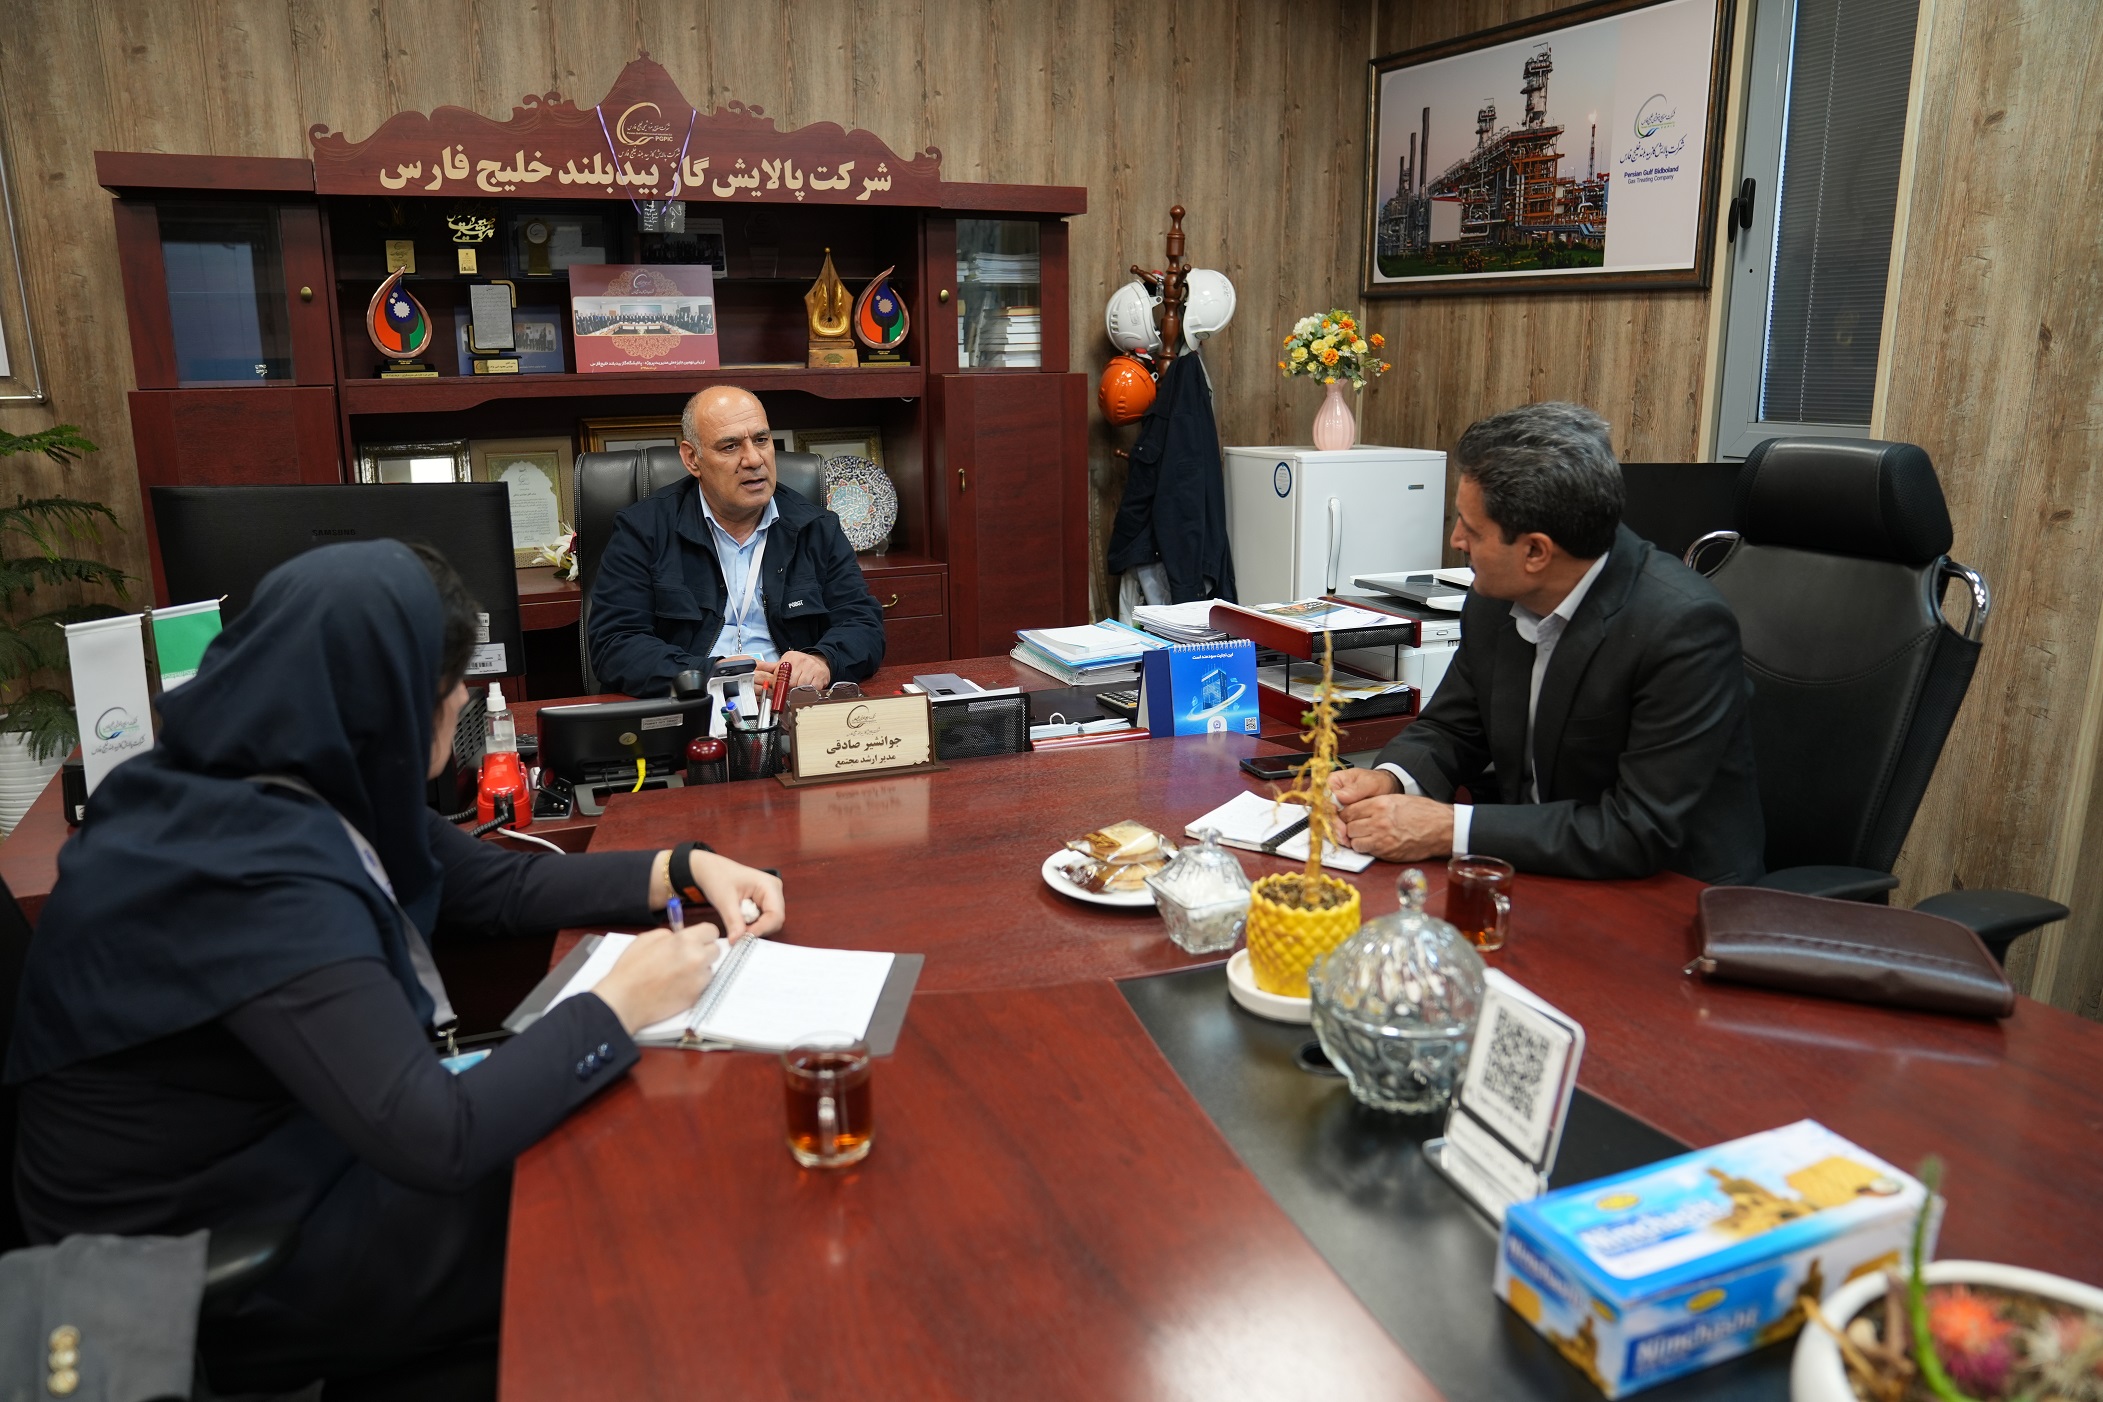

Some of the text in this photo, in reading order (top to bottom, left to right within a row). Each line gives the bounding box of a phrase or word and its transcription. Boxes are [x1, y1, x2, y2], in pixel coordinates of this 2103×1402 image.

[380, 144, 470, 190] فارس
[476, 150, 552, 193] خلیج
[665, 155, 709, 197] گاز
[712, 158, 804, 202] پالایش
[809, 161, 892, 201] شرکت
[1654, 166, 1679, 174] Bidboland
[312, 529, 356, 537] SAMSUNG
[826, 736, 902, 754] جوانشیر صادقی
[835, 754, 896, 768] مدیر ارشد مجتمع
